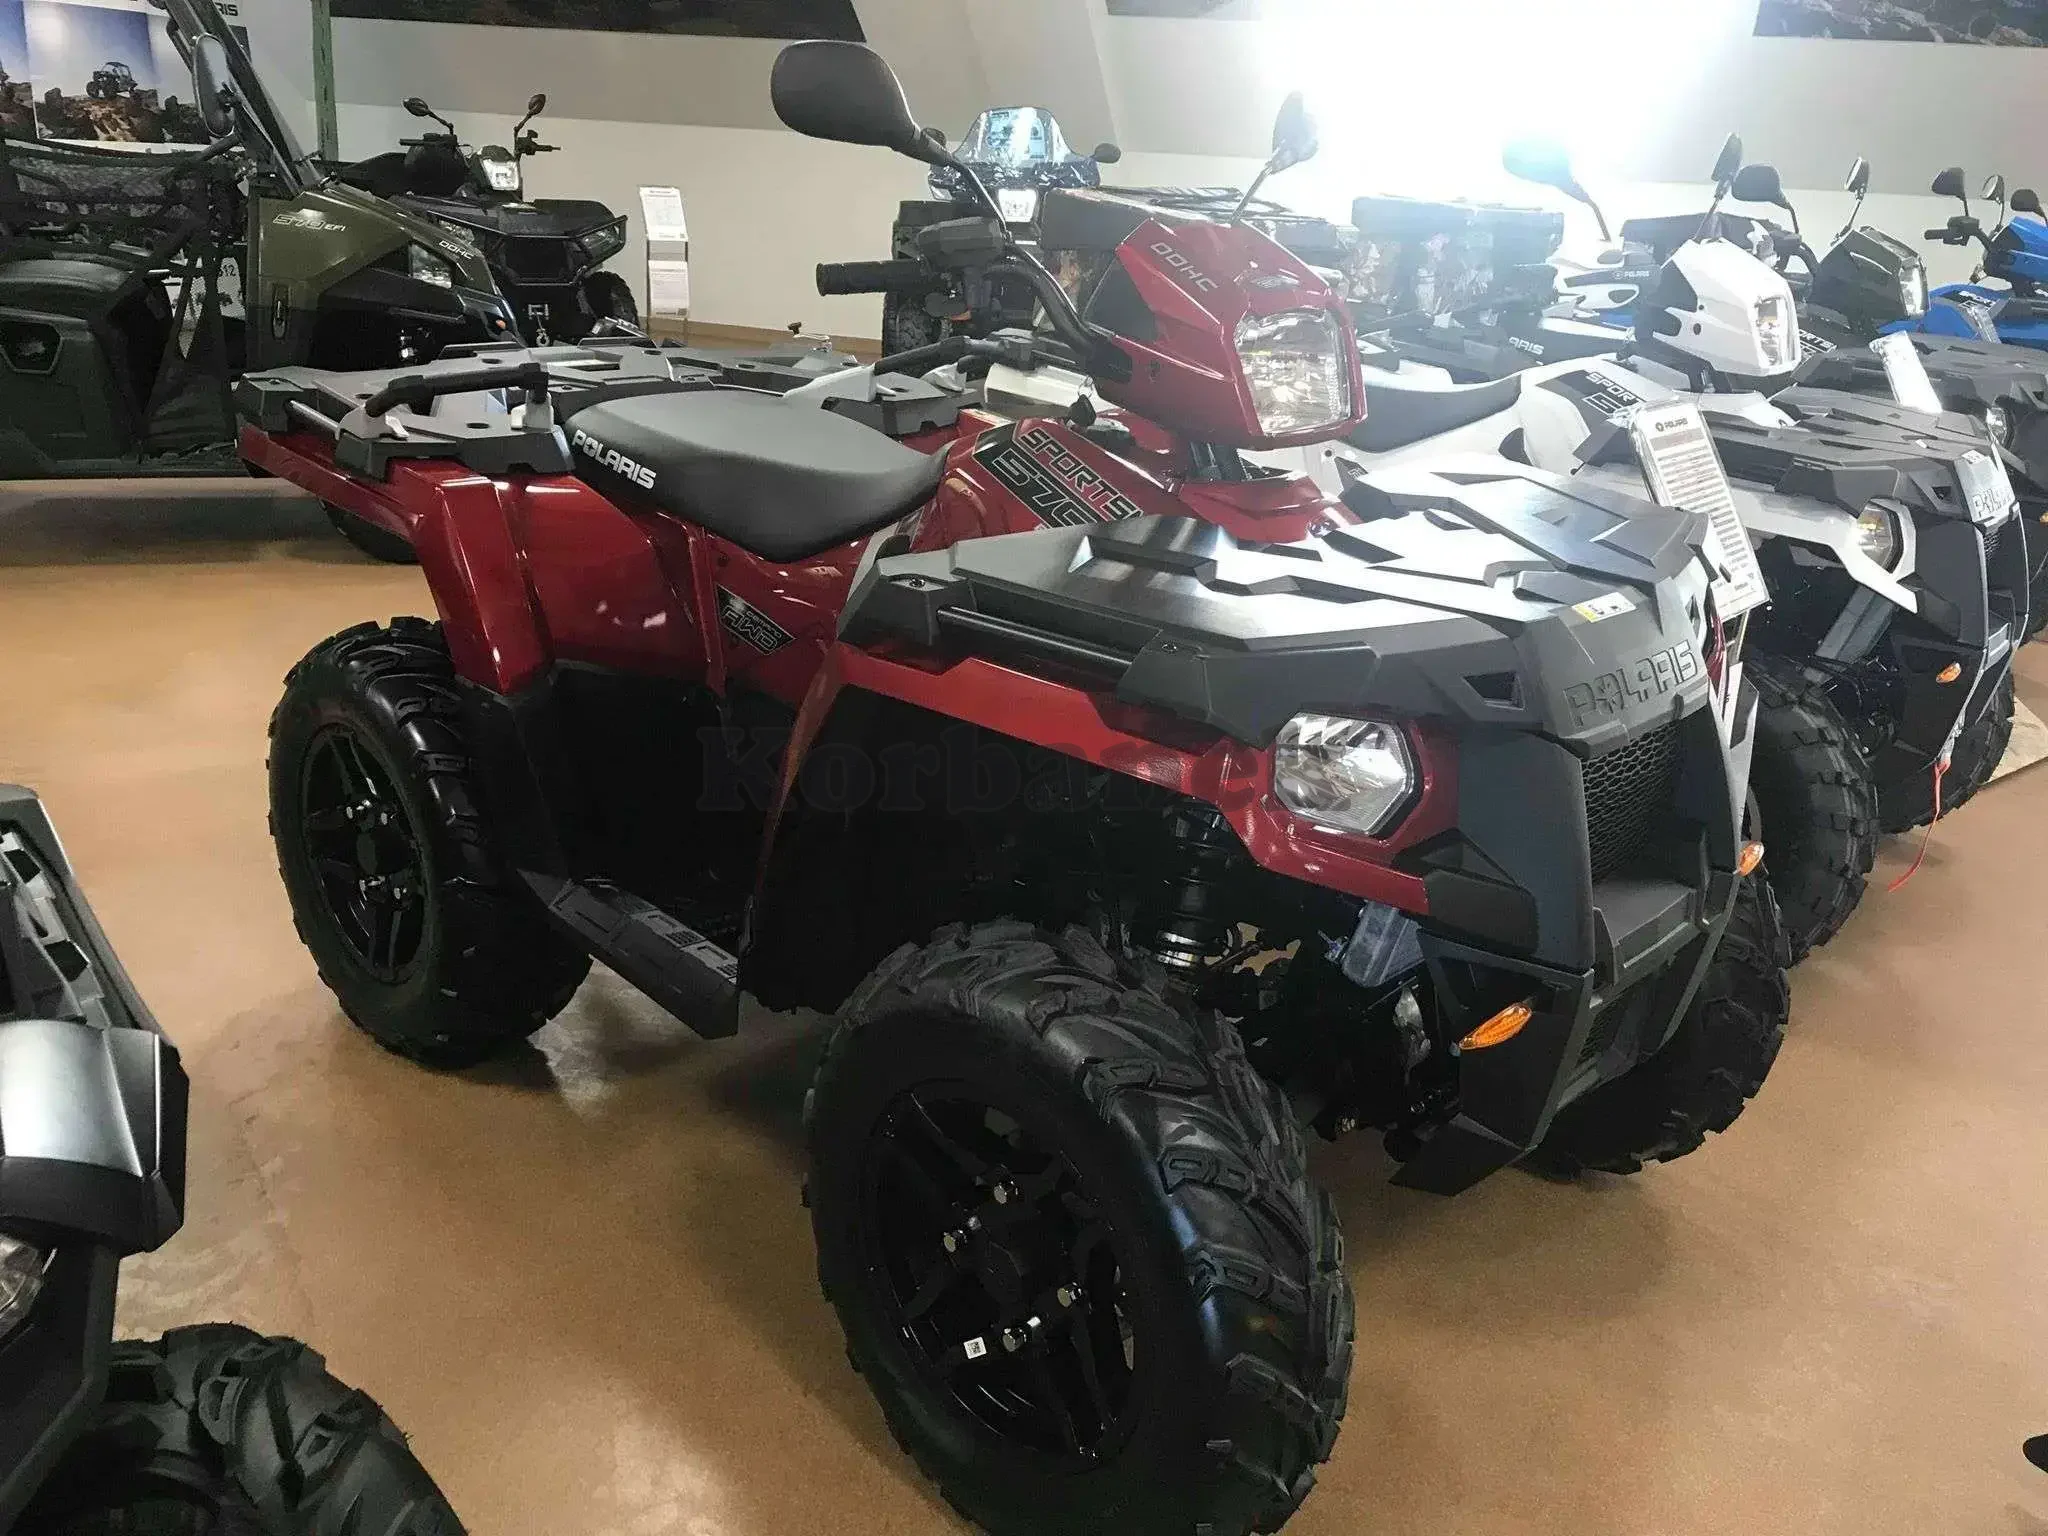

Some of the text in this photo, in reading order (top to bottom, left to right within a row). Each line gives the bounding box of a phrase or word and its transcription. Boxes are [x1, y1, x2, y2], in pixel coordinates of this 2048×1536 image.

[439, 240, 474, 260] DOHC
[1150, 242, 1219, 292] DOHC
[571, 429, 657, 490] POLARIS
[1018, 427, 1144, 522] SPORTS
[722, 605, 779, 652] AWD
[1562, 638, 1698, 729] POLARIS
